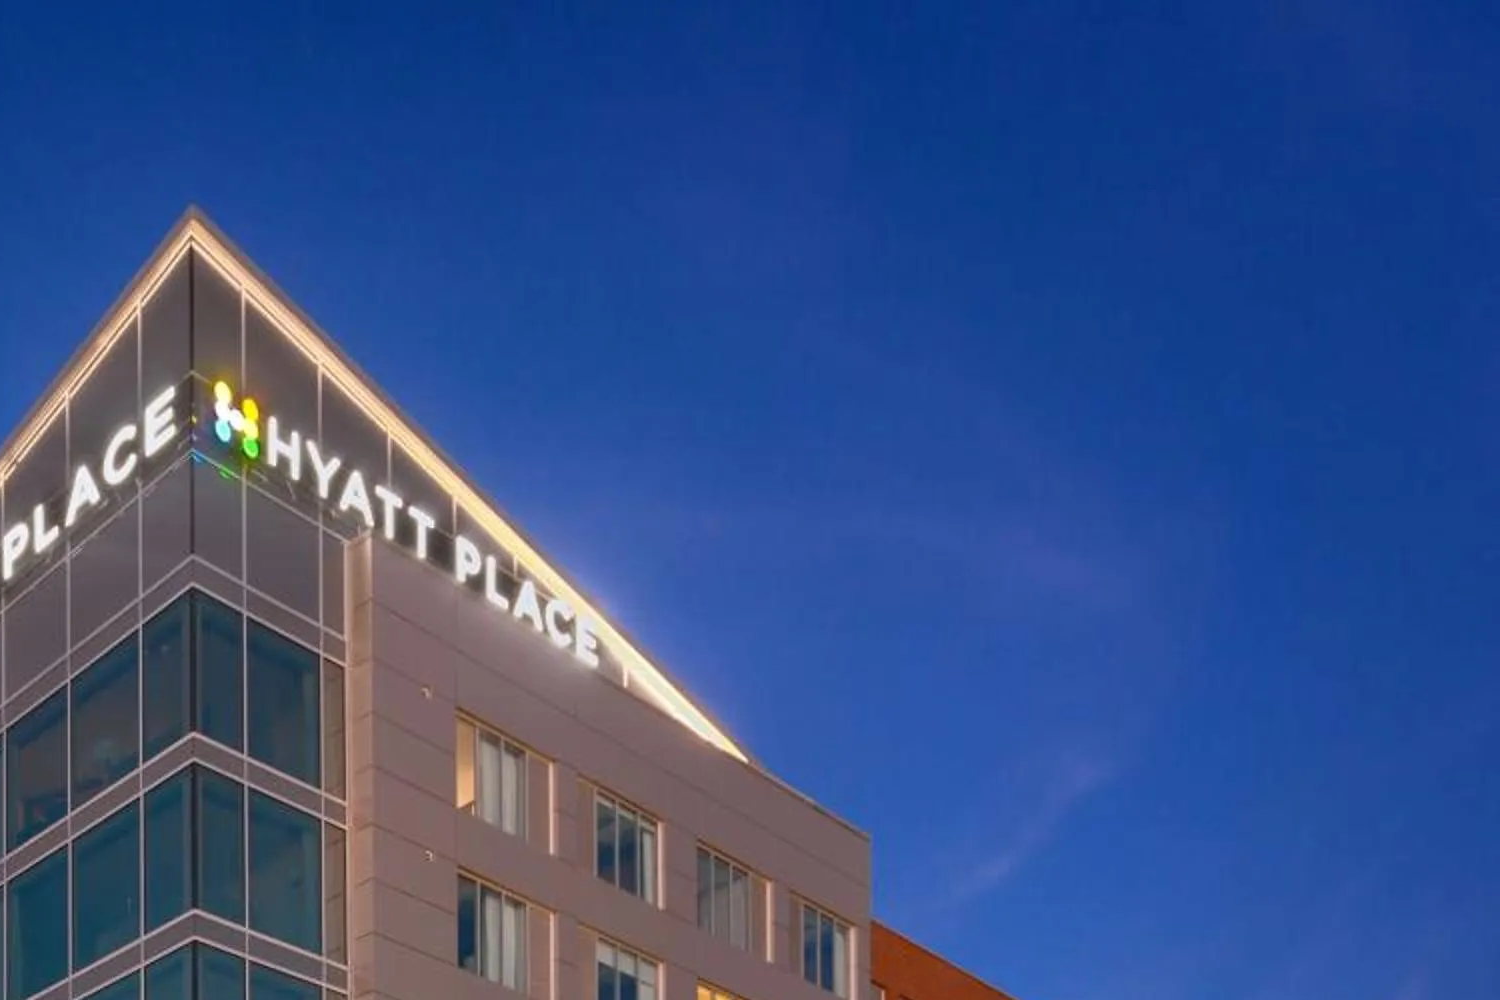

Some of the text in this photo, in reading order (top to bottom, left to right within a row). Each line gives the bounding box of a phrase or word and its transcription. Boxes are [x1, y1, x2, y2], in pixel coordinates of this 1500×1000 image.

[2, 385, 177, 581] PLACE
[266, 415, 601, 668] HYATT PLACE
